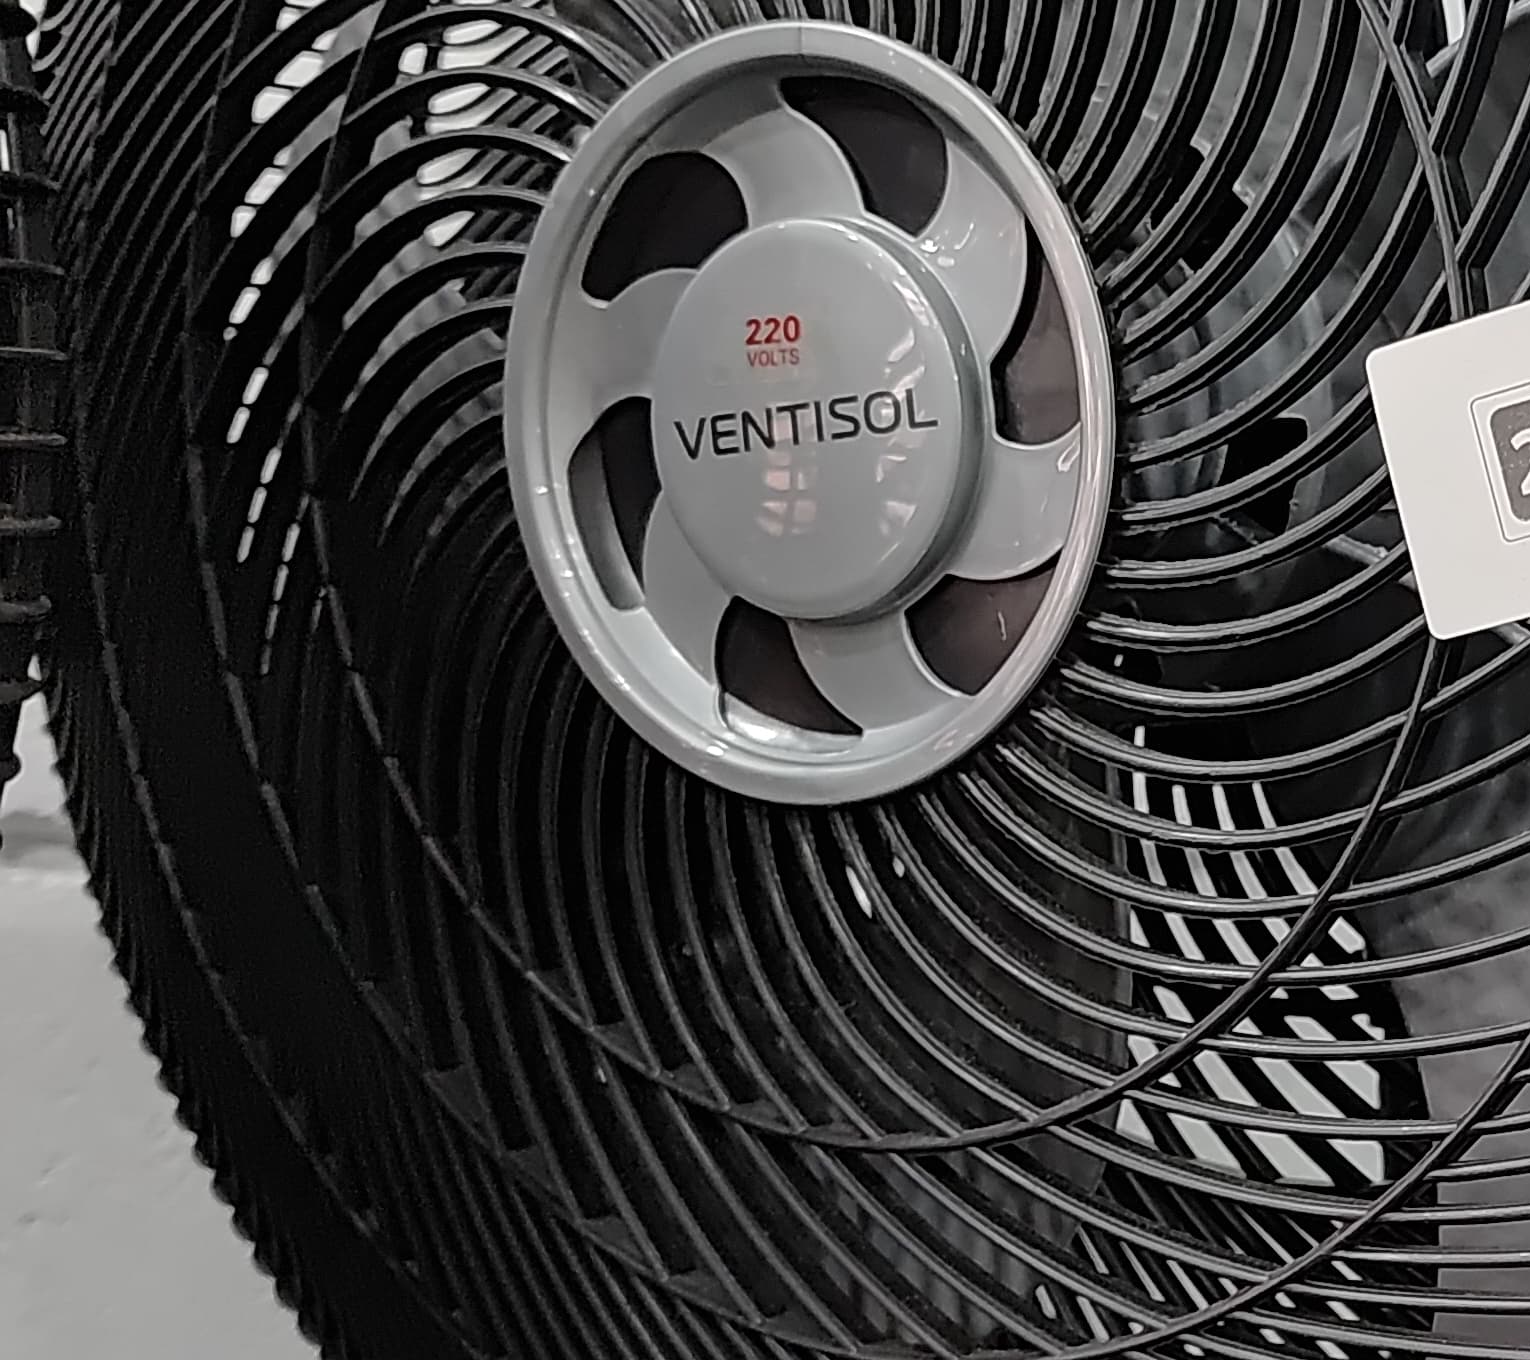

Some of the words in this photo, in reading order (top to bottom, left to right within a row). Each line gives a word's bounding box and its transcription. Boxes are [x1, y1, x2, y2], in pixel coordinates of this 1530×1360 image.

[745, 315, 801, 345] 220
[746, 348, 800, 368] VOLTS
[673, 388, 939, 460] VENTISOL
